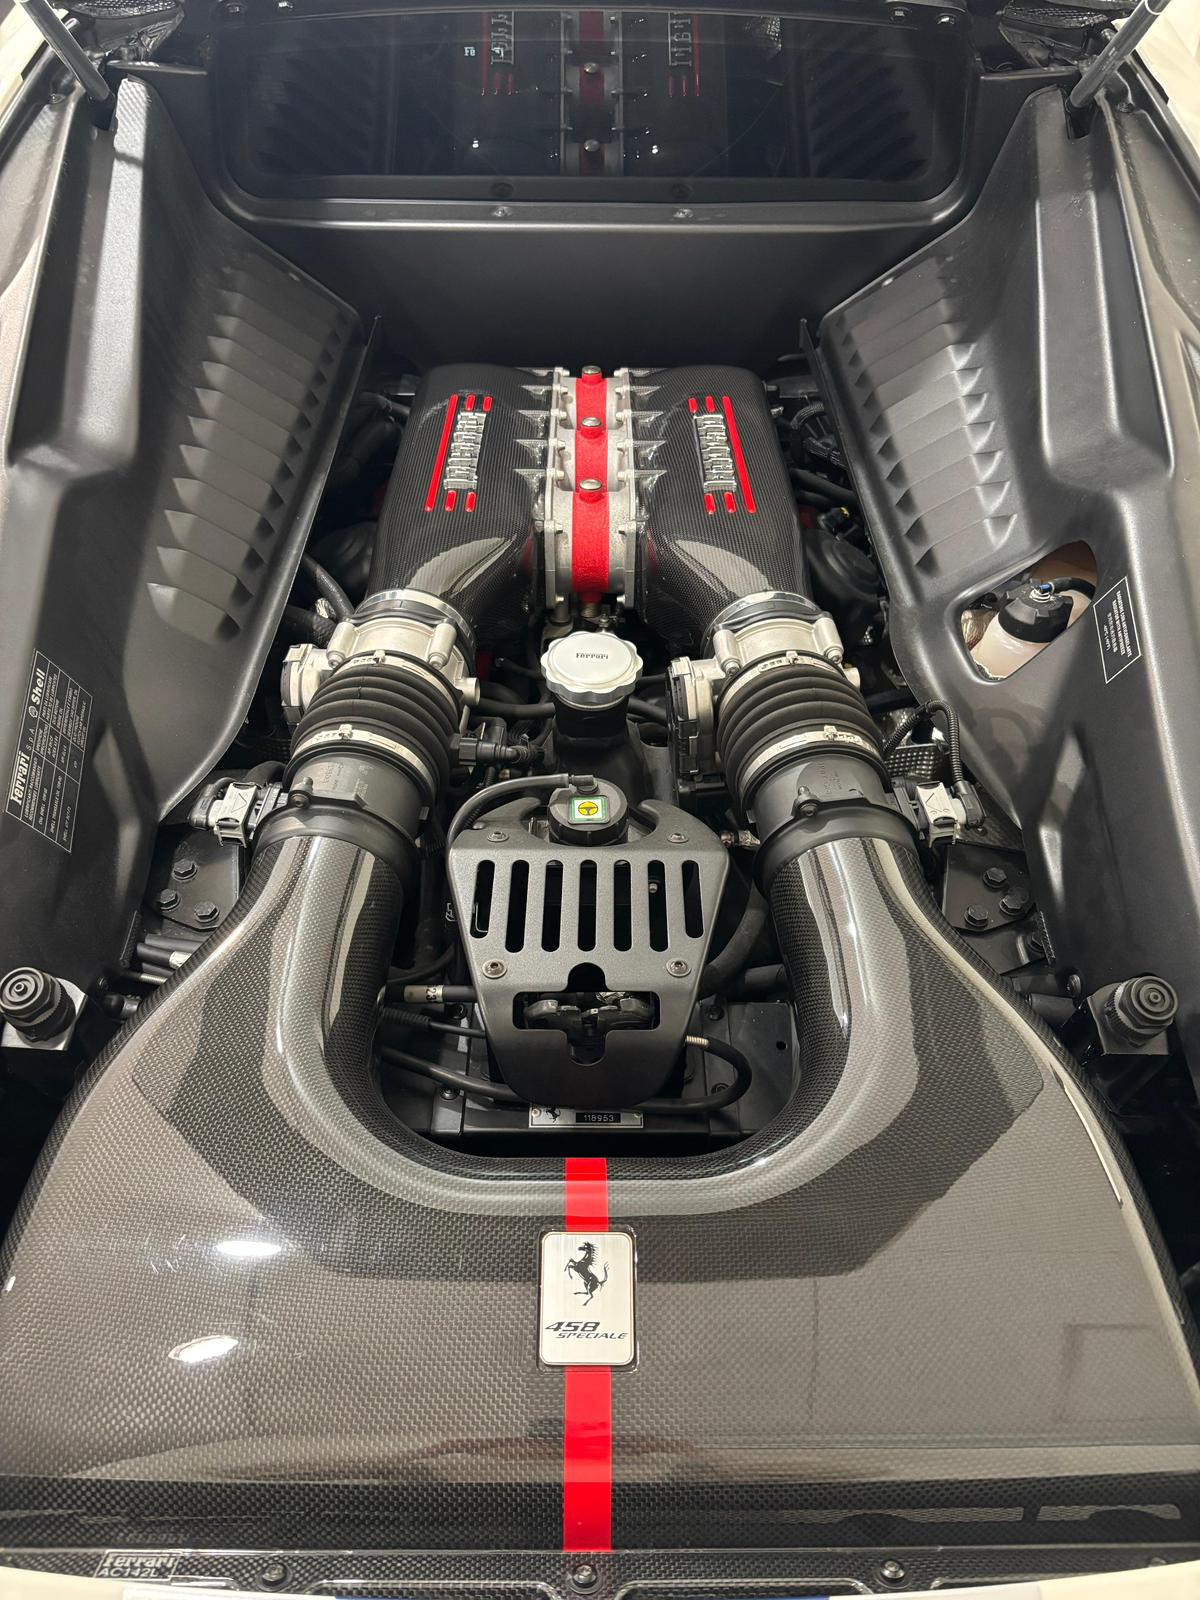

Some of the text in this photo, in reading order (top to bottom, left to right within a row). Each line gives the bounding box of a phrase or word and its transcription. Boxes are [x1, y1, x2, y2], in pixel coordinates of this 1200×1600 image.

[575, 652, 609, 660] Ferrari
[30, 666, 45, 706] Shell
[10, 749, 29, 806] Ferrari
[583, 1114, 615, 1123] 118953
[545, 1321, 601, 1333] 458
[555, 1332, 629, 1340] SPECIALE
[102, 1554, 175, 1568] Ferrari
